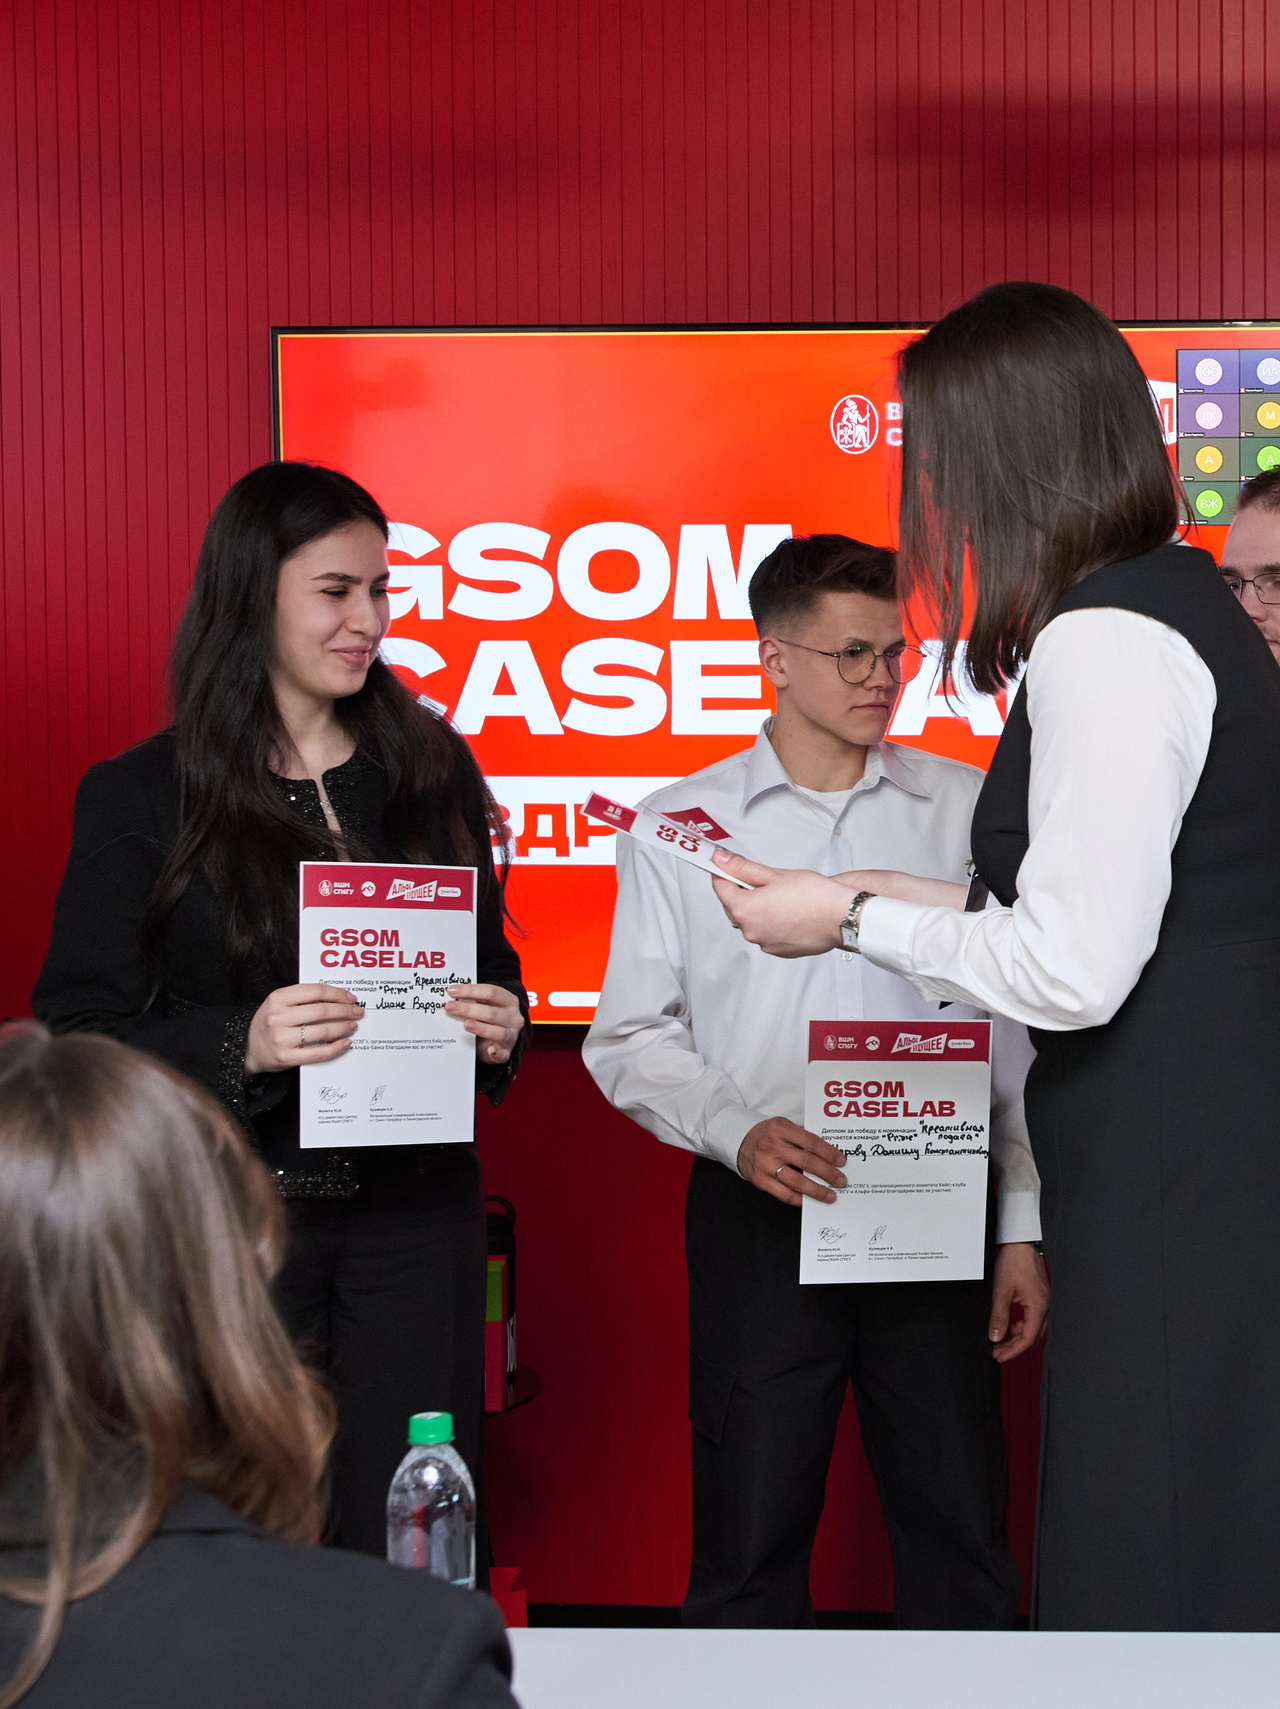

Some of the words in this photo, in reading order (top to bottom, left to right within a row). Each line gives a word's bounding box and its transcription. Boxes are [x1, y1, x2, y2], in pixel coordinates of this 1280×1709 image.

[1262, 366, 1279, 376] ИА
[1202, 411, 1217, 422] ДК
[1265, 411, 1276, 420] М
[1200, 499, 1218, 508] ВЖ
[320, 928, 400, 947] GSOM
[320, 950, 395, 968] CASE
[398, 951, 447, 969] LAB
[353, 979, 374, 987] победу
[823, 1080, 905, 1098] GSOM
[823, 1100, 899, 1118] CASE
[902, 1100, 956, 1118] LAB
[856, 1127, 877, 1135] победу
